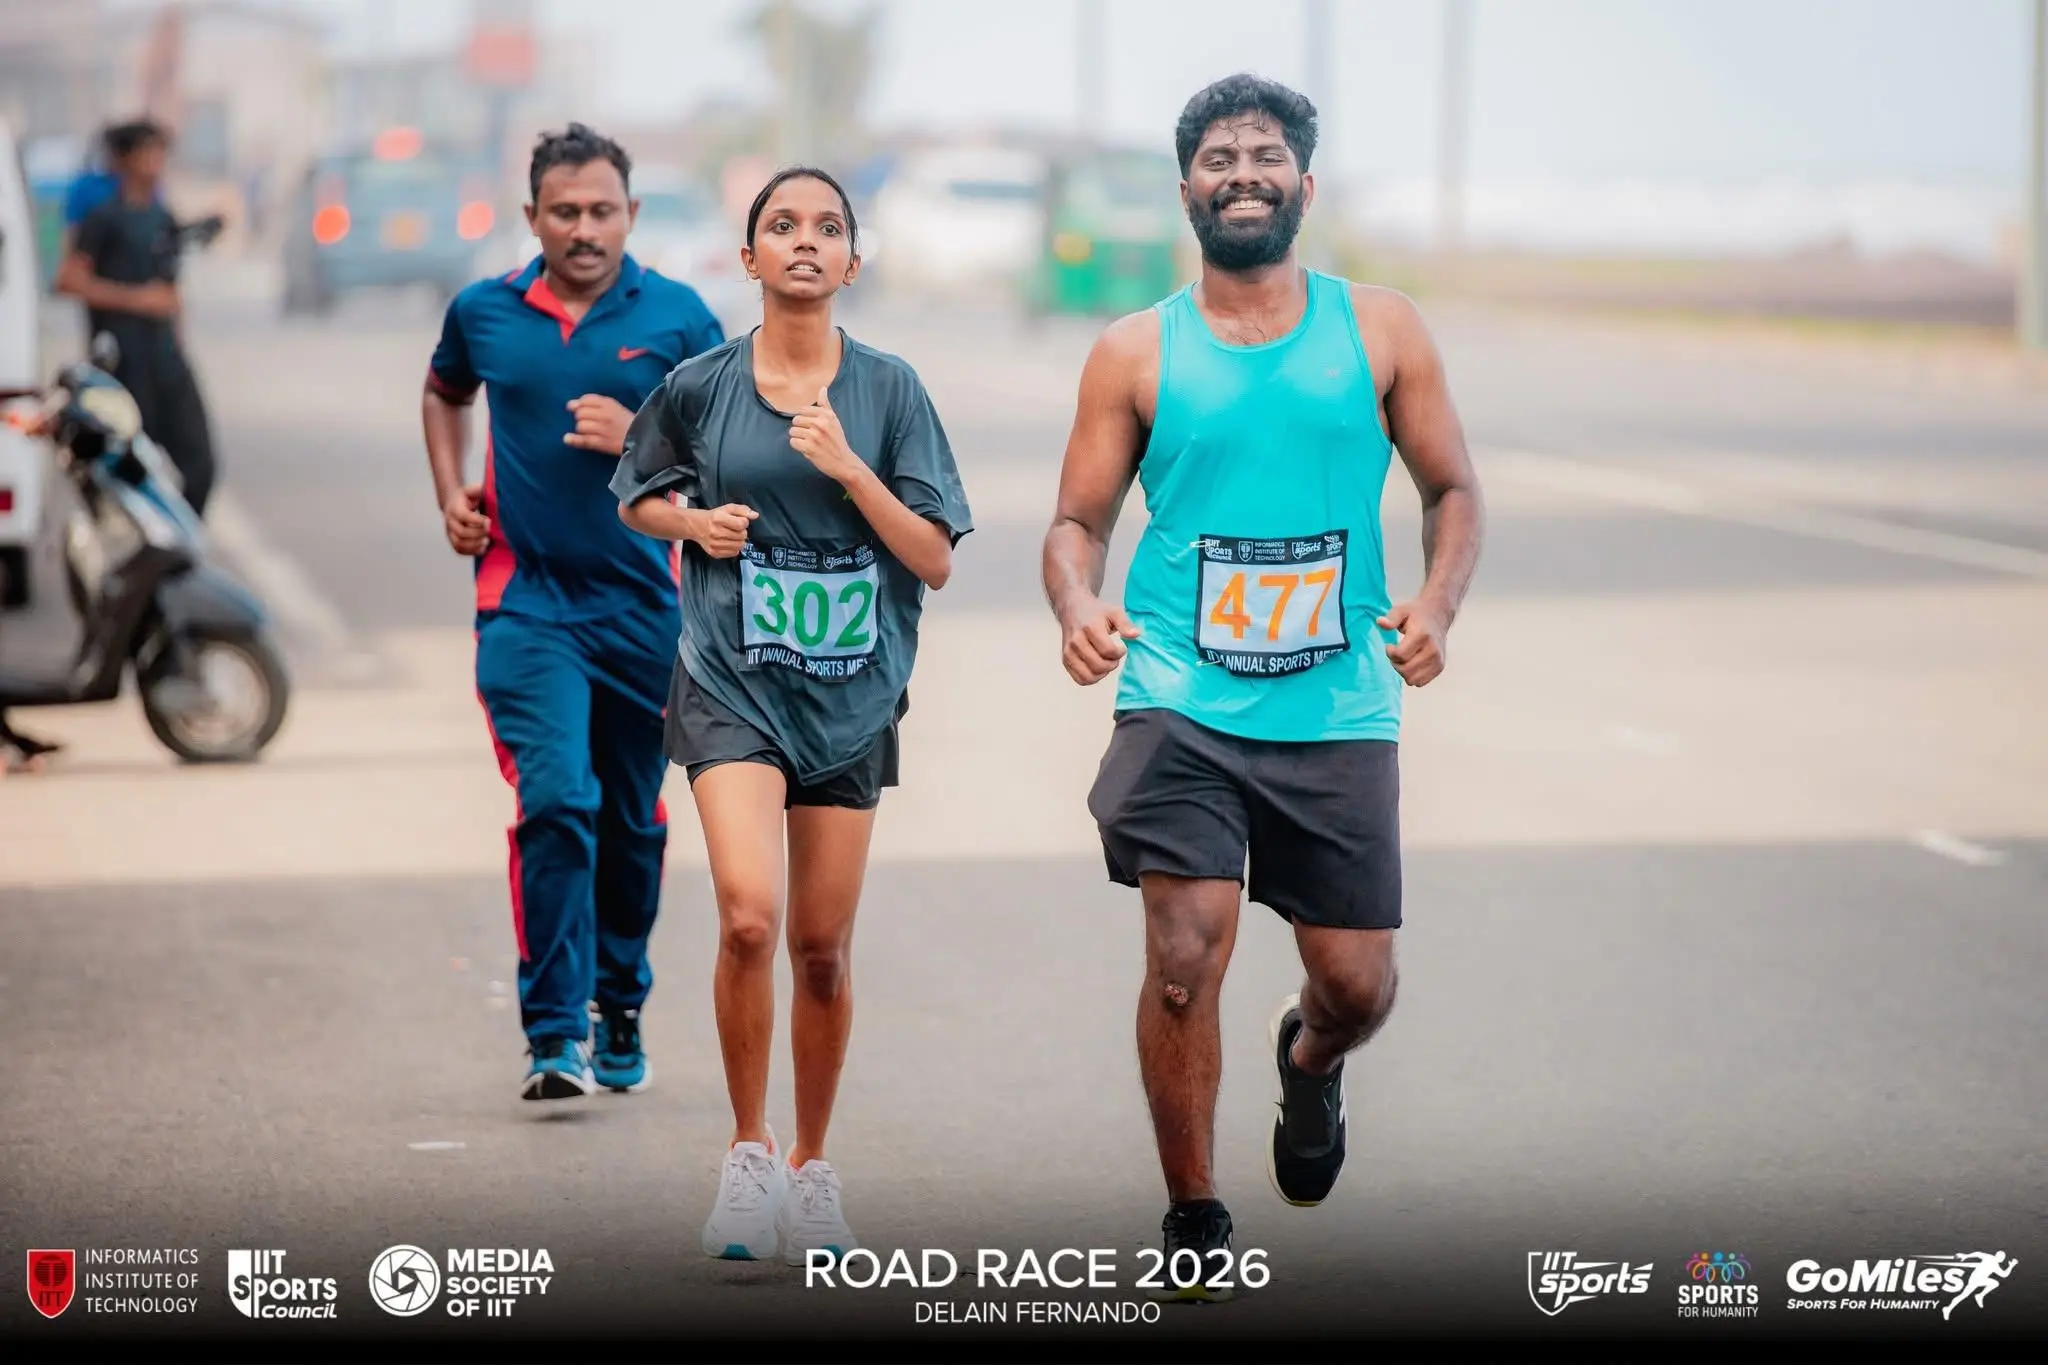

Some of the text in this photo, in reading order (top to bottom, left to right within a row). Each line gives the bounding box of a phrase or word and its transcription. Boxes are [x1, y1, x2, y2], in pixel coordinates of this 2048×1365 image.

[752, 573, 873, 648] 302
[1210, 568, 1336, 641] 477
[747, 648, 761, 665] IIT
[761, 647, 803, 670] ANNUAL
[805, 659, 844, 676] SPORTS
[1268, 651, 1311, 673] SPORTS
